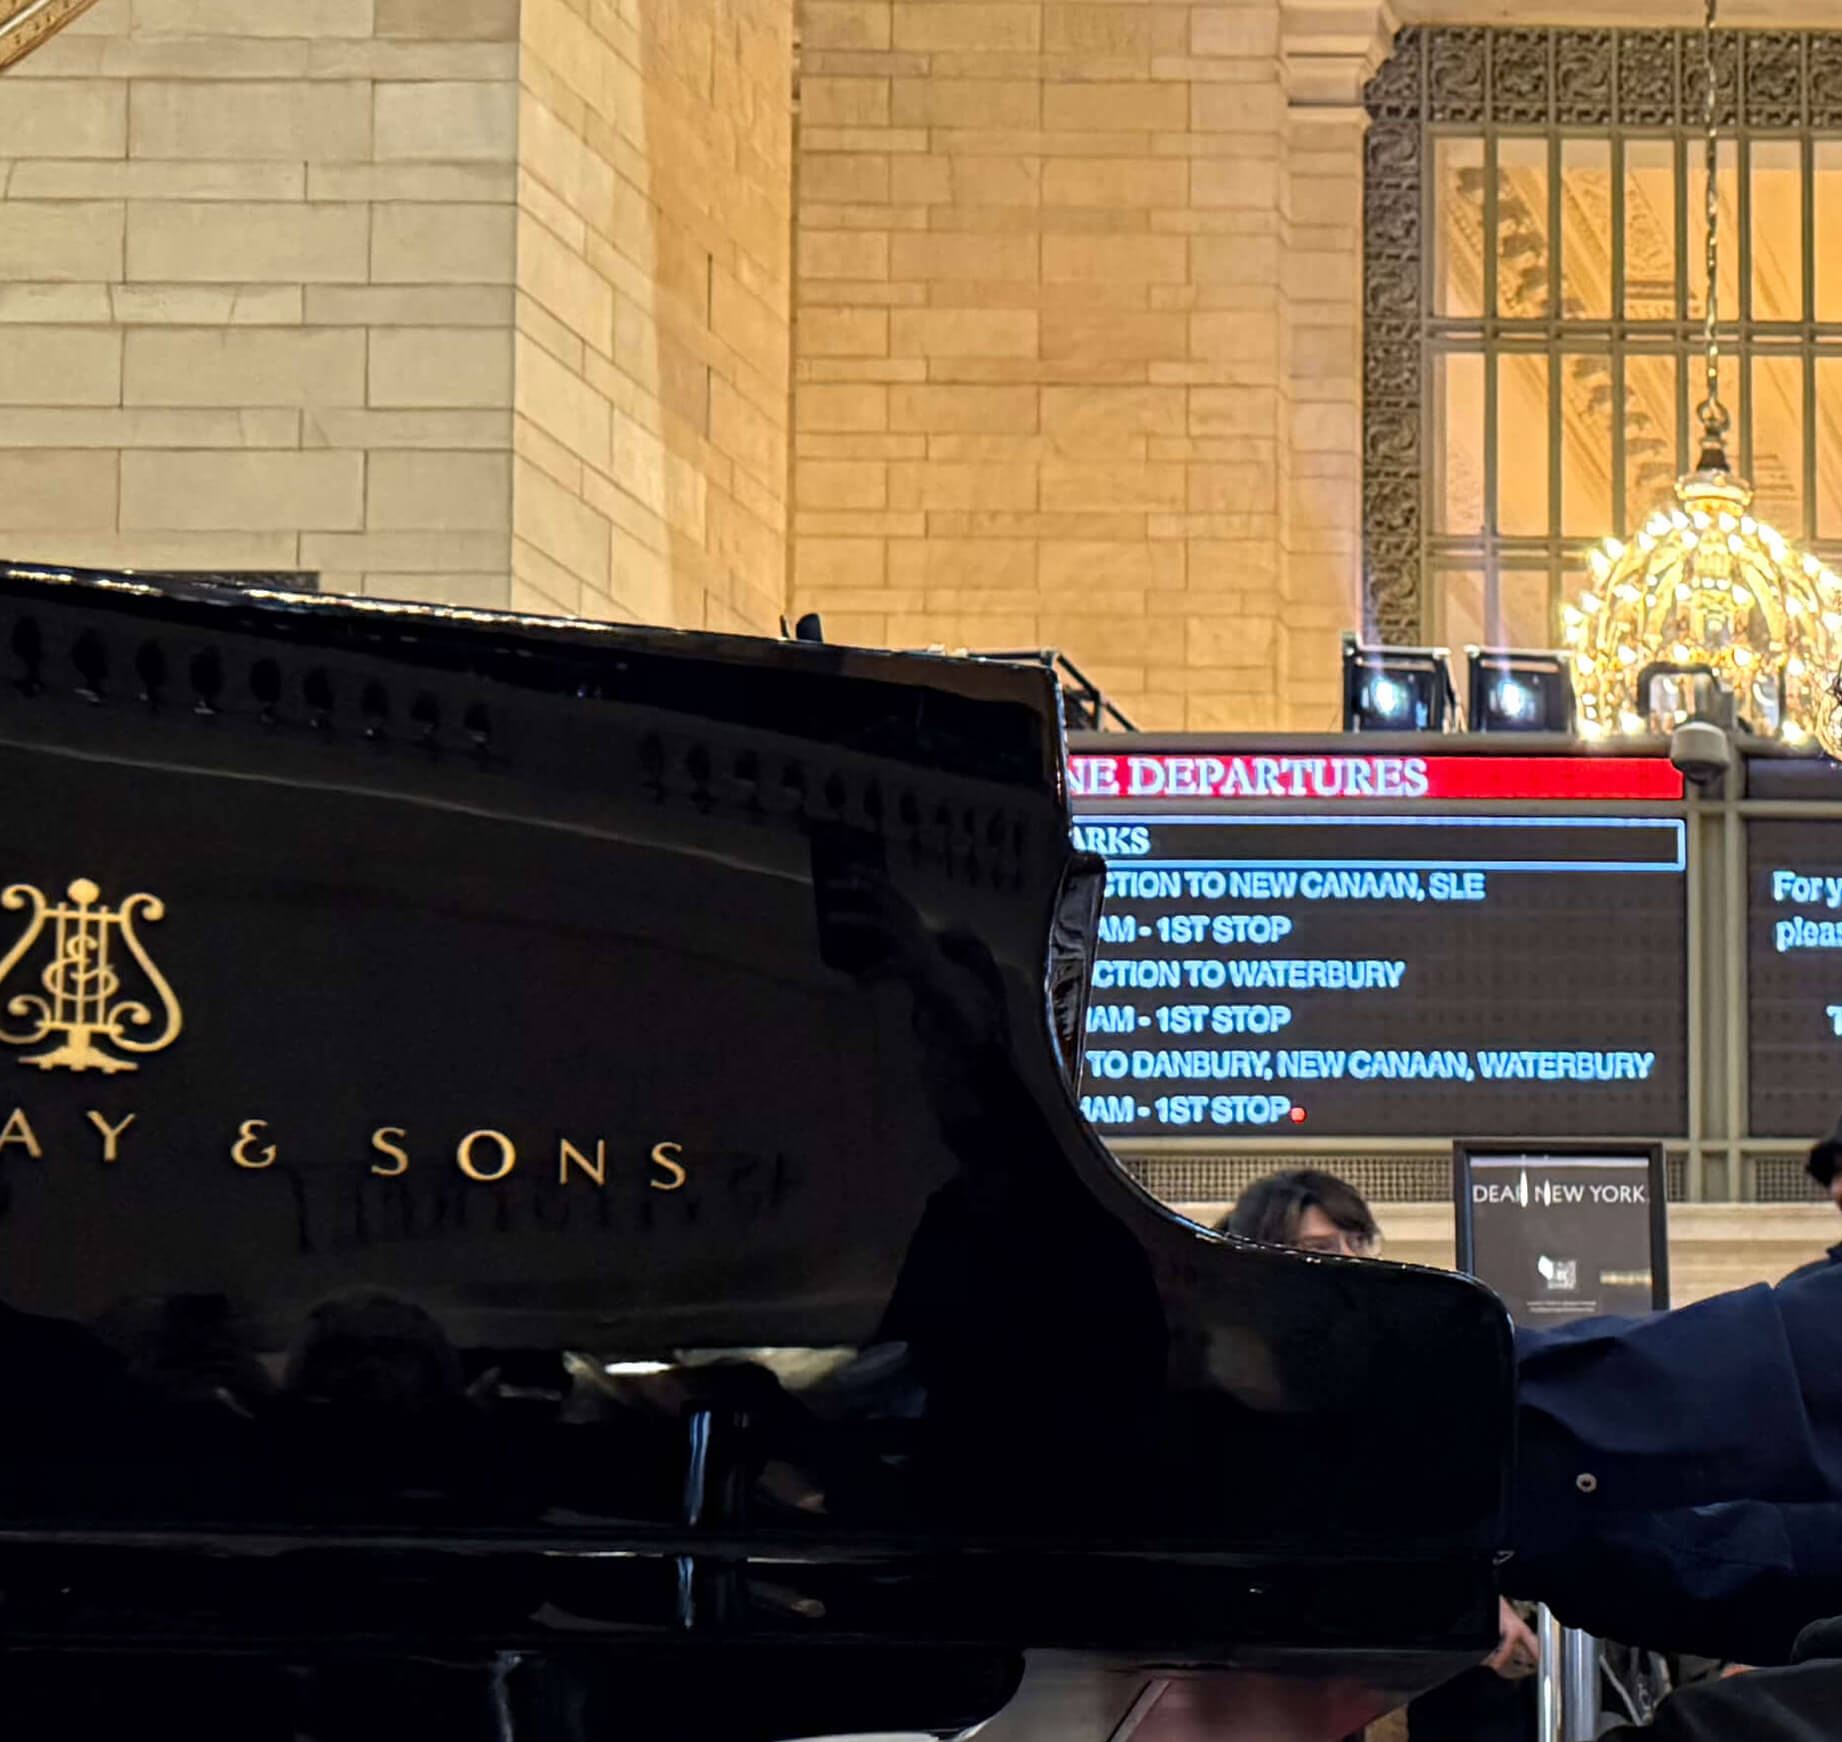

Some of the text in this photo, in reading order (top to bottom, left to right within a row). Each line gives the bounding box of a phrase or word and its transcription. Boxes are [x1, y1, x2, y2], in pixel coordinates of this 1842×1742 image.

[1127, 758, 1429, 797] DEPARTURES
[1183, 871, 1227, 899] TO
[1230, 871, 1298, 900] NEW
[1299, 872, 1426, 903] CANAAN,
[1428, 873, 1486, 901] SLE
[1773, 871, 1824, 903] For
[1156, 915, 1211, 943] 1ST
[1212, 915, 1292, 943] STOP
[1091, 960, 1406, 989] CTION TO WATERBURY
[1155, 1005, 1210, 1033] 1ST
[1211, 1005, 1292, 1034] STOP
[1085, 1050, 1655, 1083] TO DANBURY, NEW CANAAN, WATERBURY
[1154, 1096, 1210, 1124] 1ST
[1210, 1096, 1291, 1125] STOP
[231, 1119, 277, 1168] &
[371, 1126, 687, 1190] SONS
[1589, 1184, 1647, 1204] YORK
